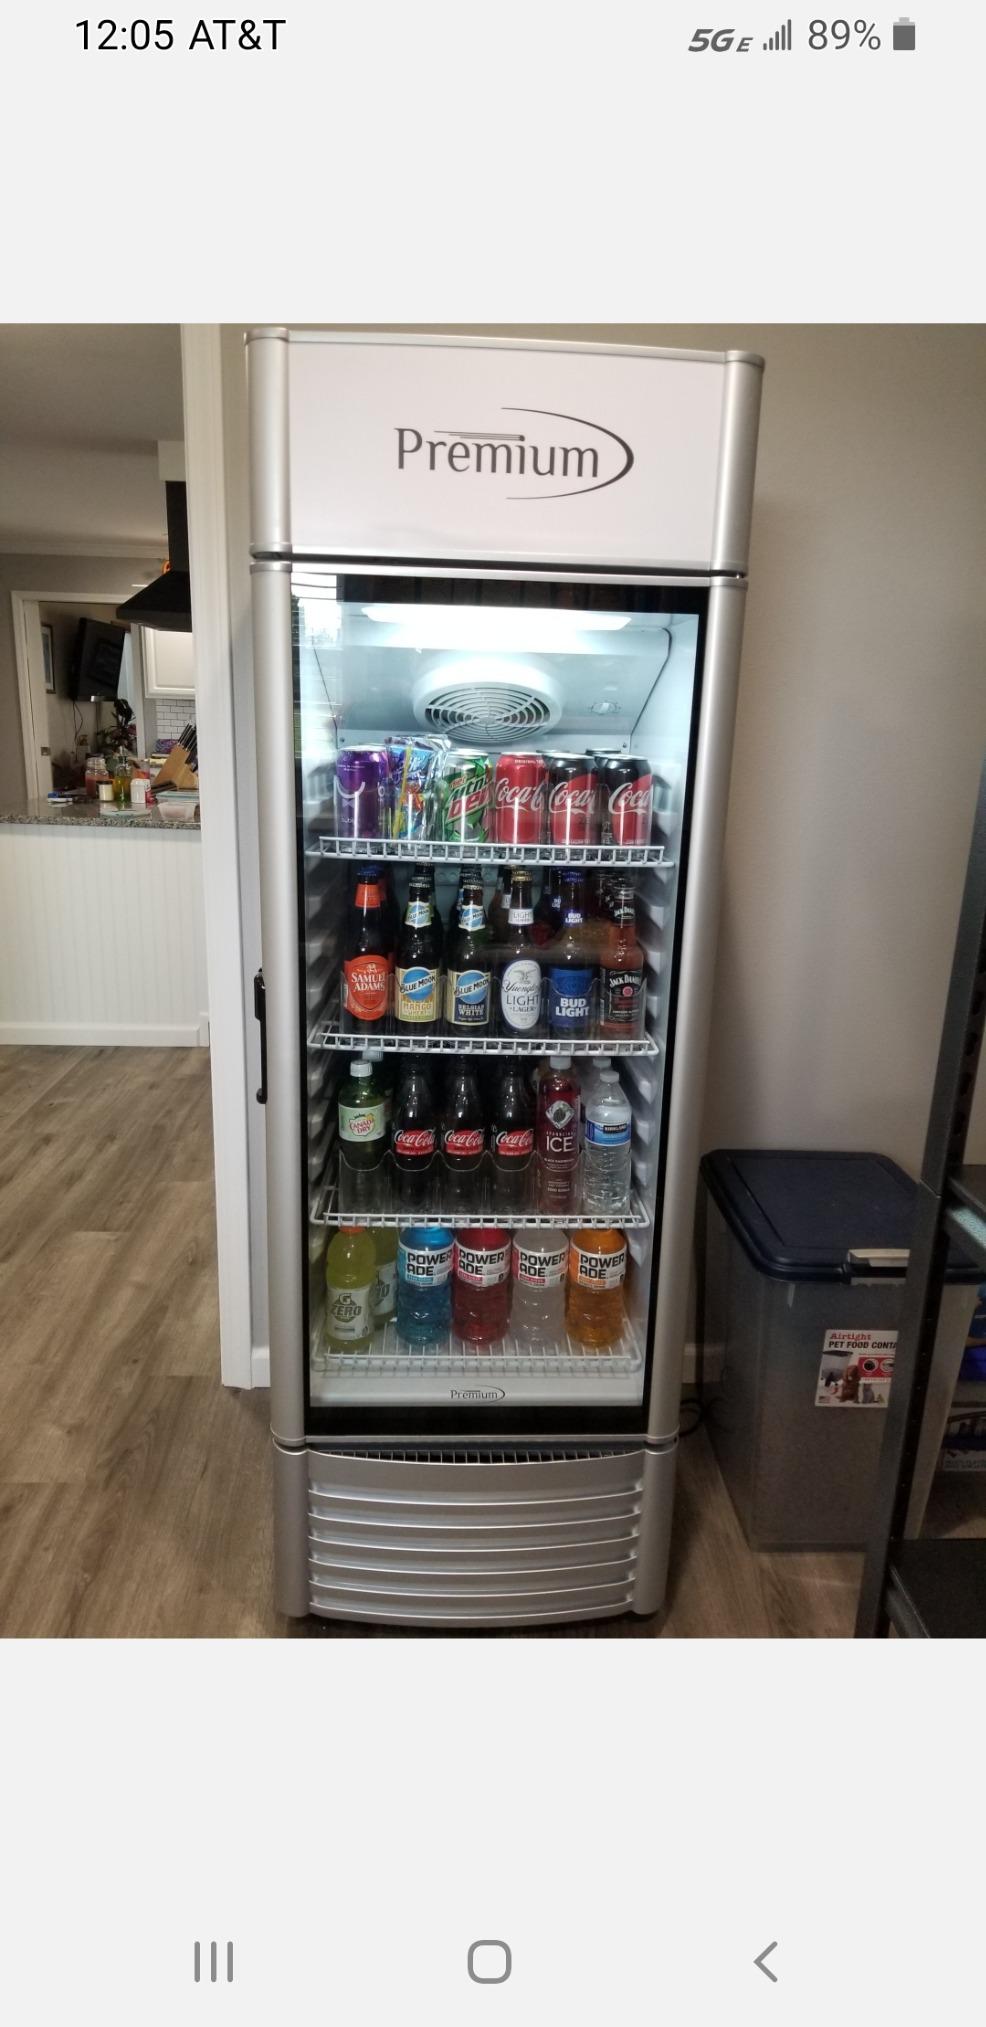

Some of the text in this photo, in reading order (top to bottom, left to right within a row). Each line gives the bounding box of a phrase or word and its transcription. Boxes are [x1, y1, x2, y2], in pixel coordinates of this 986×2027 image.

[394, 426, 600, 478] Premium
[355, 982, 385, 992] ADAMS
[400, 975, 436, 994] BLUE MOON
[454, 978, 490, 996] BLUE MOON
[609, 979, 625, 988] JACK
[506, 994, 540, 1006] LIGHT
[560, 997, 587, 1008] BUD
[555, 1006, 590, 1017] LIGHT
[546, 1136, 573, 1152] ICE
[459, 1250, 505, 1265] POWER
[520, 1250, 566, 1266] POWER
[580, 1251, 625, 1267] POWER
[407, 1263, 434, 1276] ADE
[458, 1262, 483, 1275] ADE
[520, 1263, 546, 1276] ADE
[579, 1265, 606, 1278] ADE
[332, 1305, 362, 1317] ZERO
[846, 1341, 869, 1349] FOOD
[450, 1390, 498, 1399] Premium
